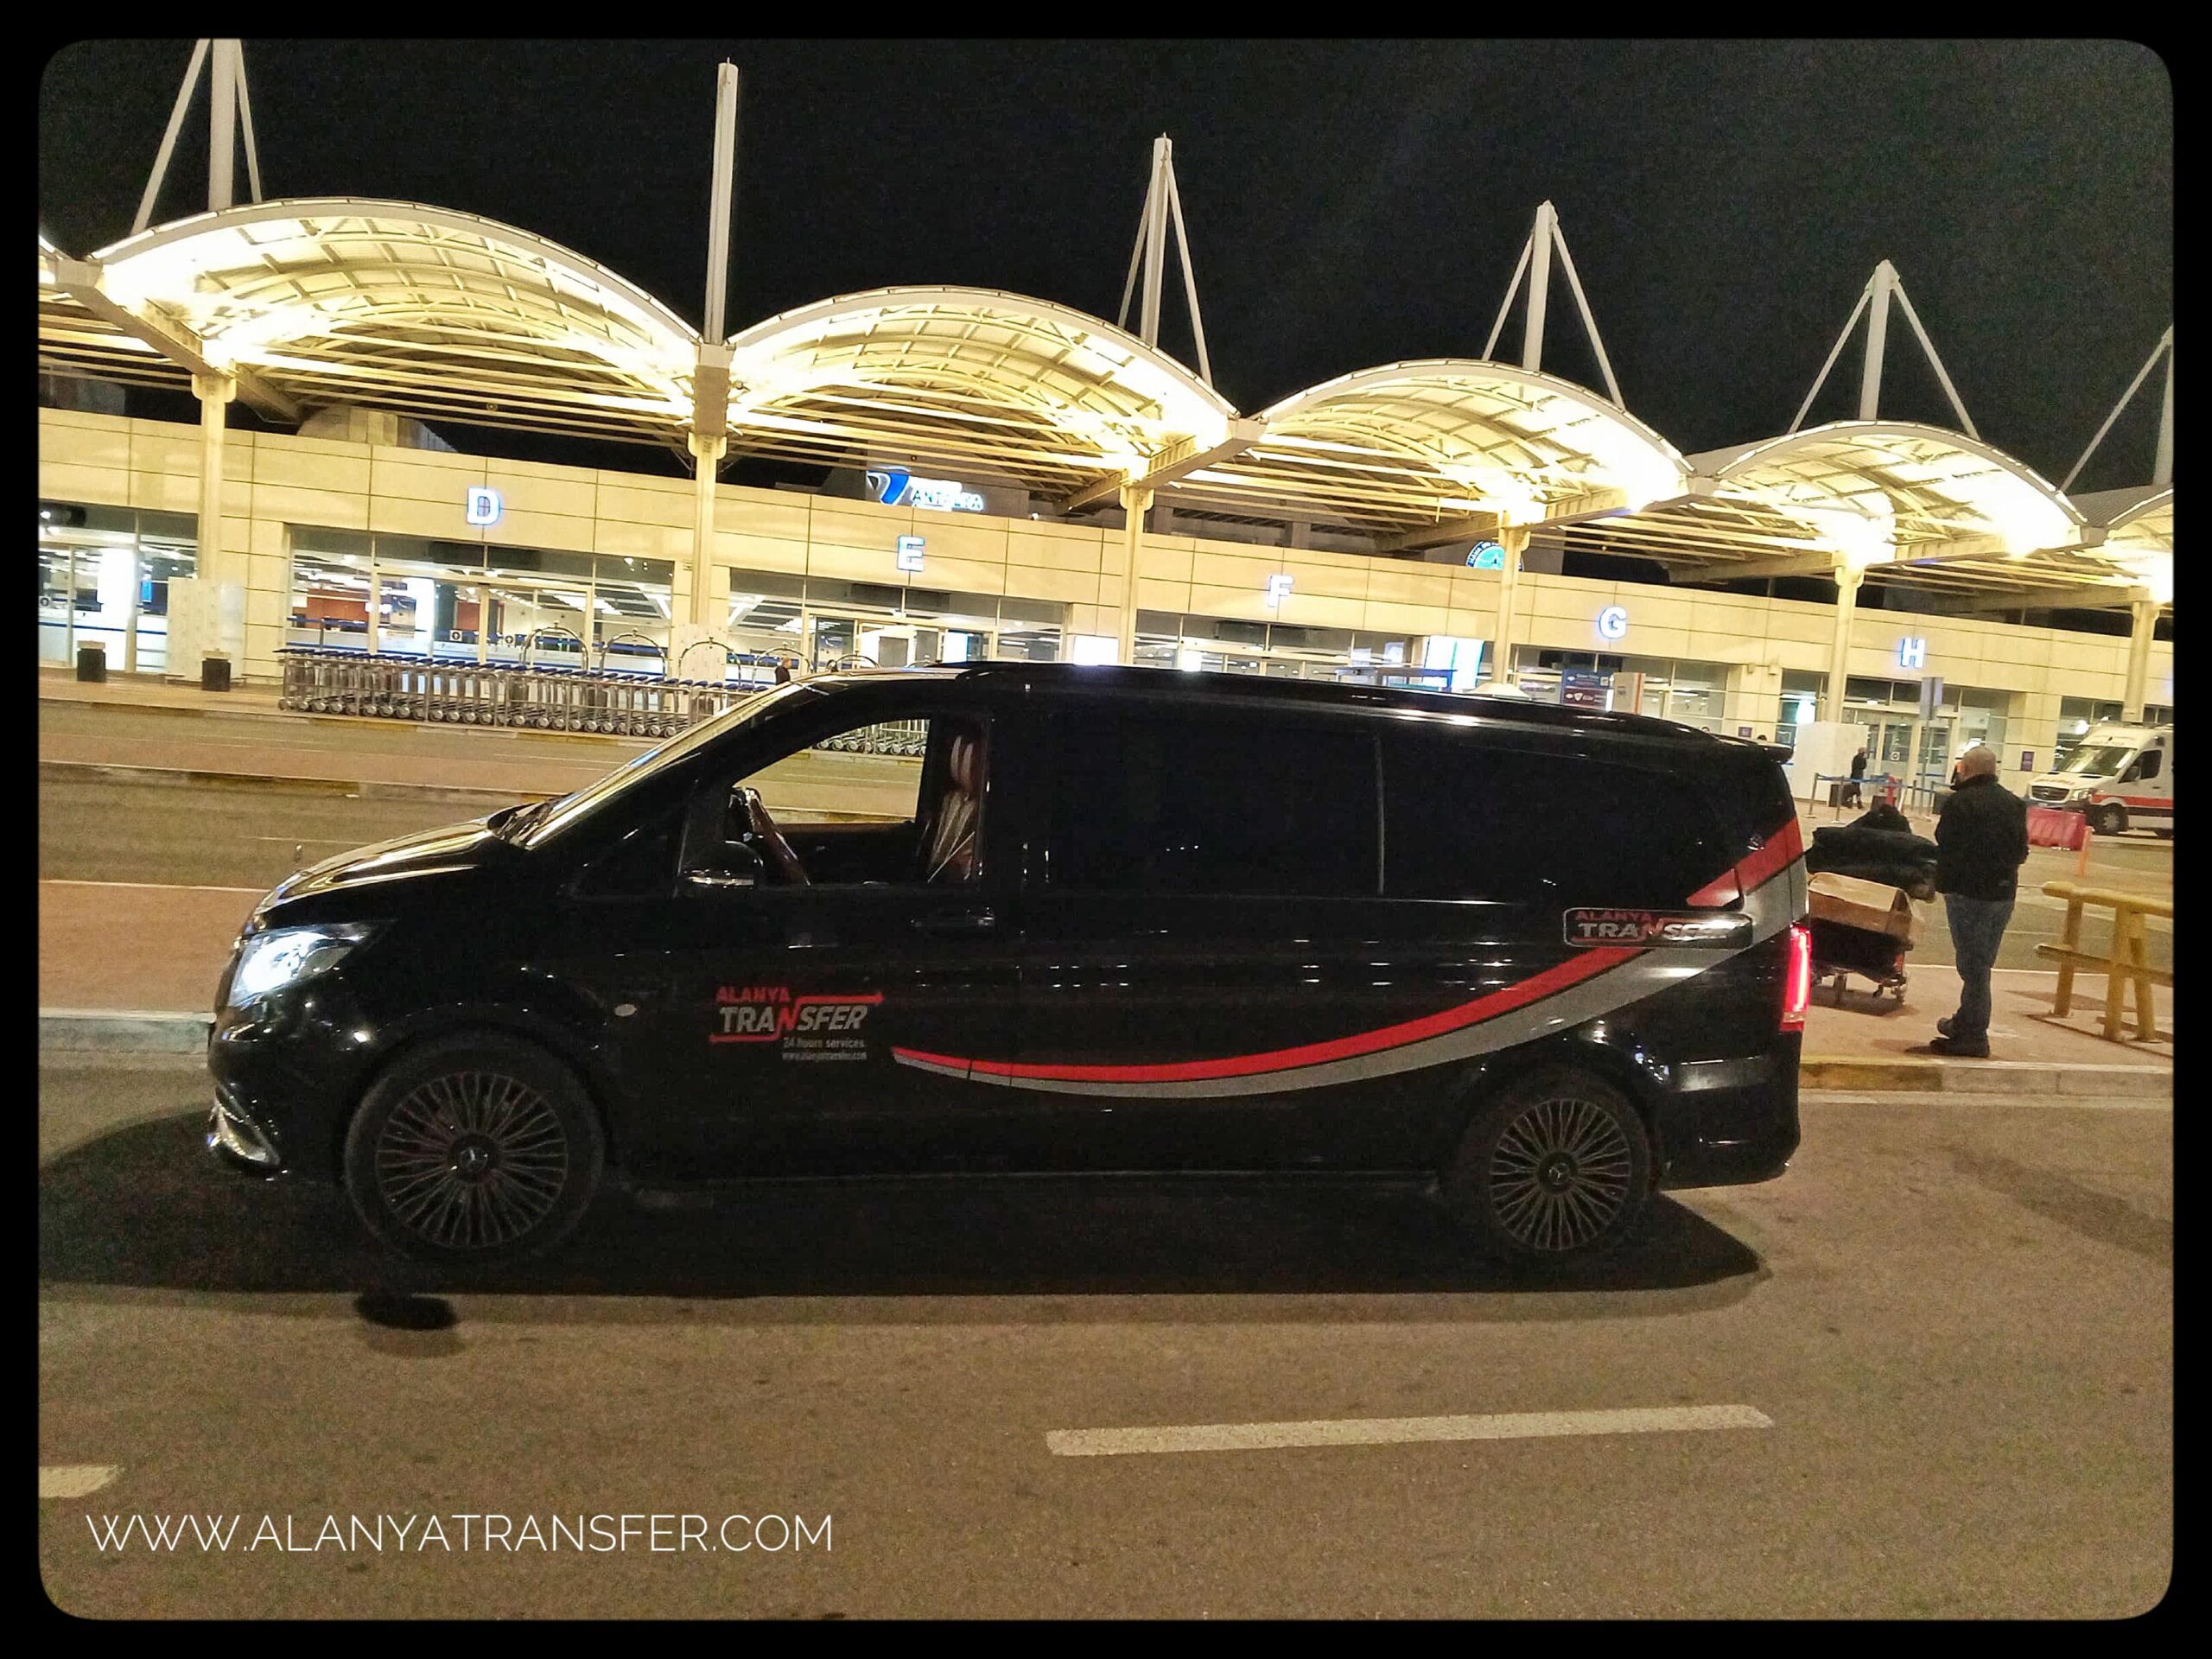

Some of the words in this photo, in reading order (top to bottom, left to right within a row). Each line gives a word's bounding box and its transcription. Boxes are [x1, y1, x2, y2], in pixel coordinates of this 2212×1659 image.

[466, 486, 500, 525] D
[897, 535, 925, 572] E
[1268, 574, 1294, 607] F
[1599, 606, 1627, 639] G
[1901, 637, 1926, 669] H
[1575, 910, 1651, 921] ALANYA
[1578, 918, 1728, 940] TRANSF
[715, 986, 791, 1003] ALANYA
[719, 1004, 868, 1033] TRANSFER
[783, 1038, 796, 1048] 24
